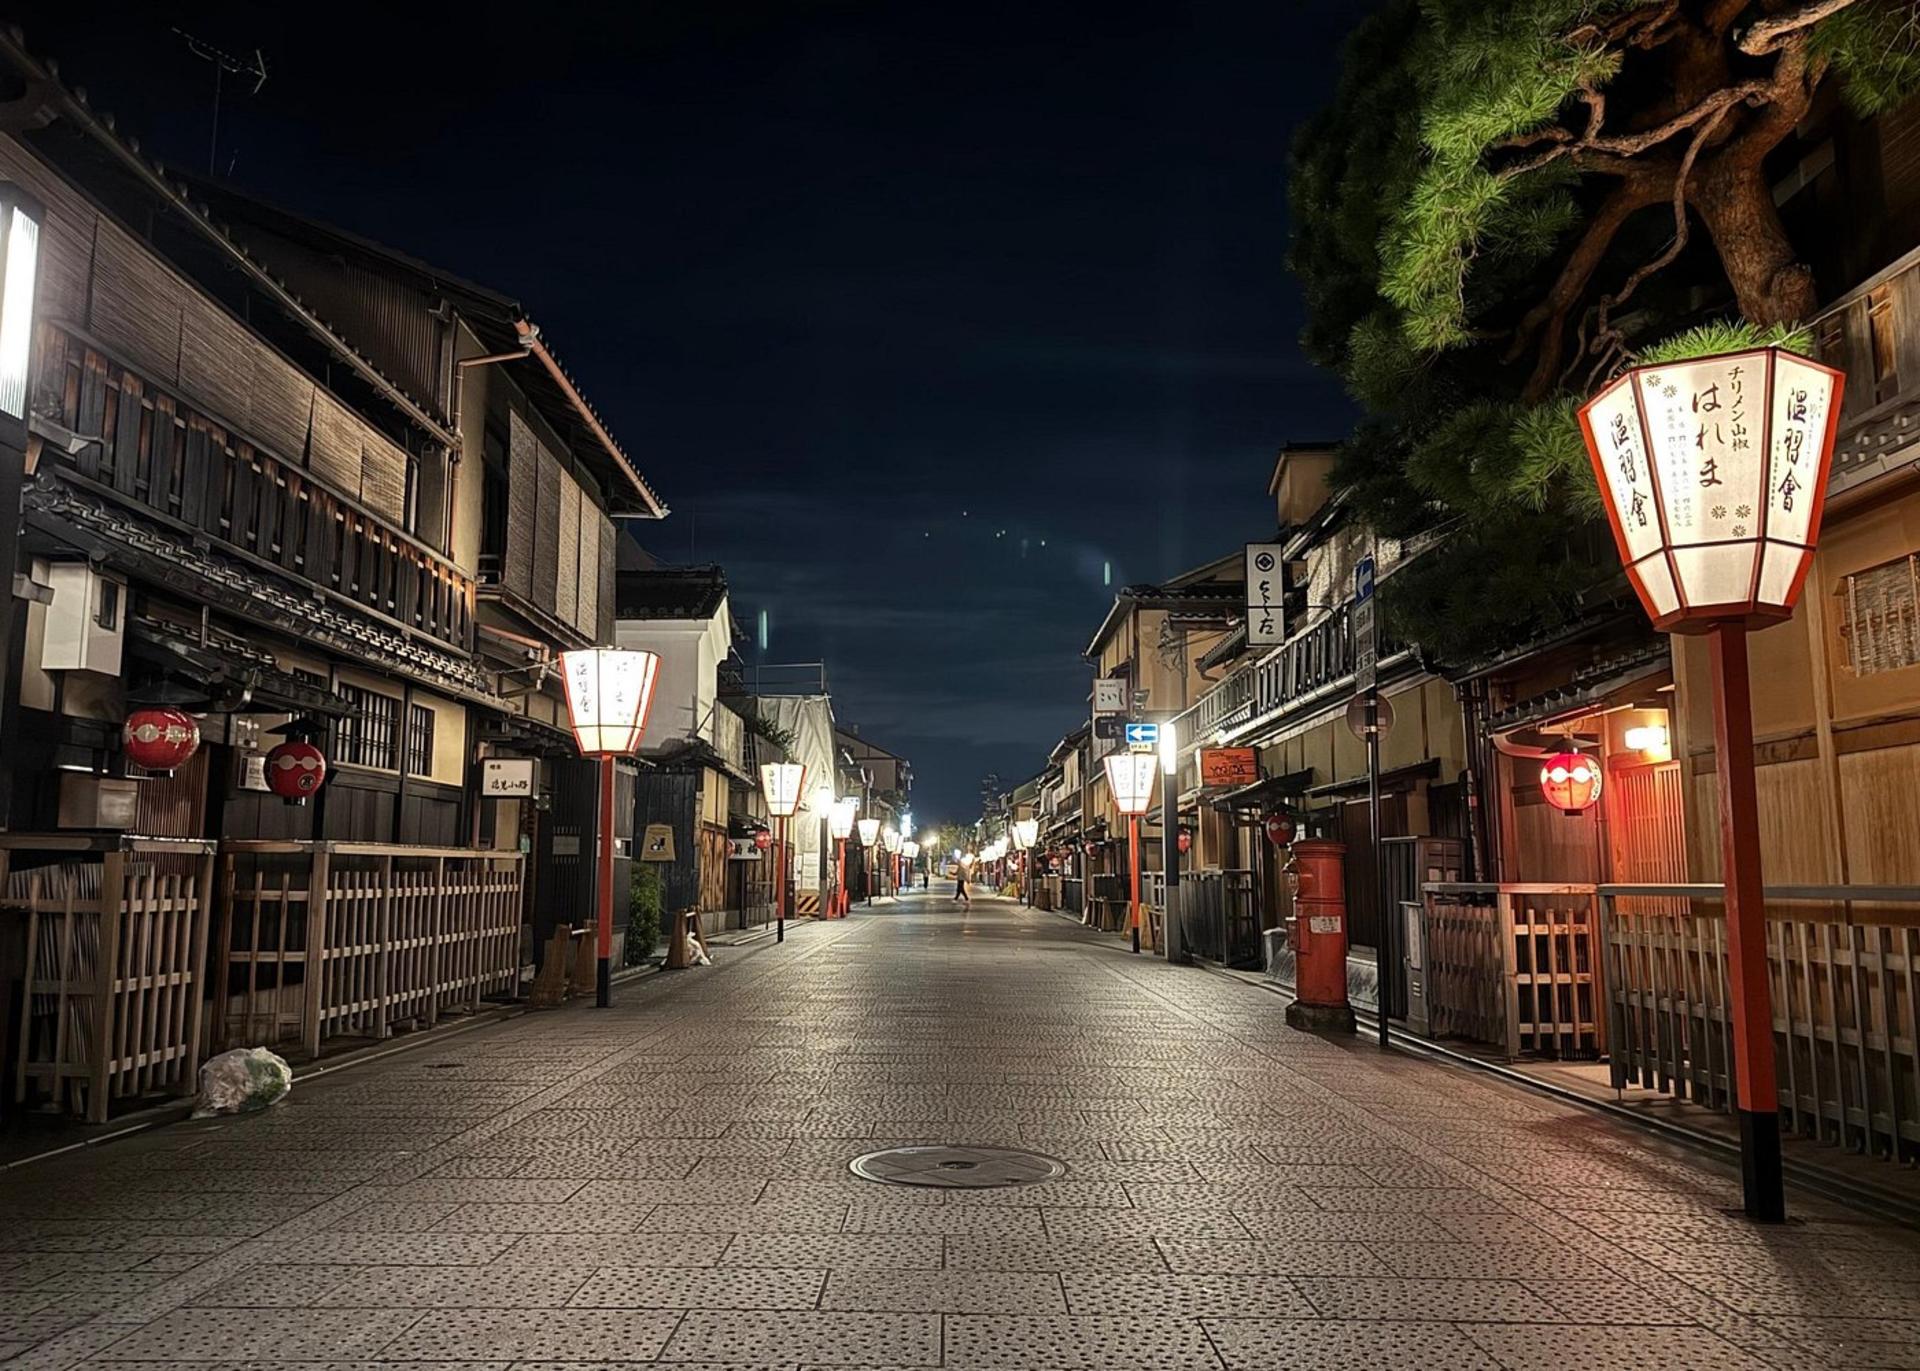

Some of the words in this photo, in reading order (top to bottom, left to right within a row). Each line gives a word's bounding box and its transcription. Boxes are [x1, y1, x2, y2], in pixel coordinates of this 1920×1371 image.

[1691, 382, 1724, 488] はれま
[1726, 365, 1748, 452] チリメン山椒
